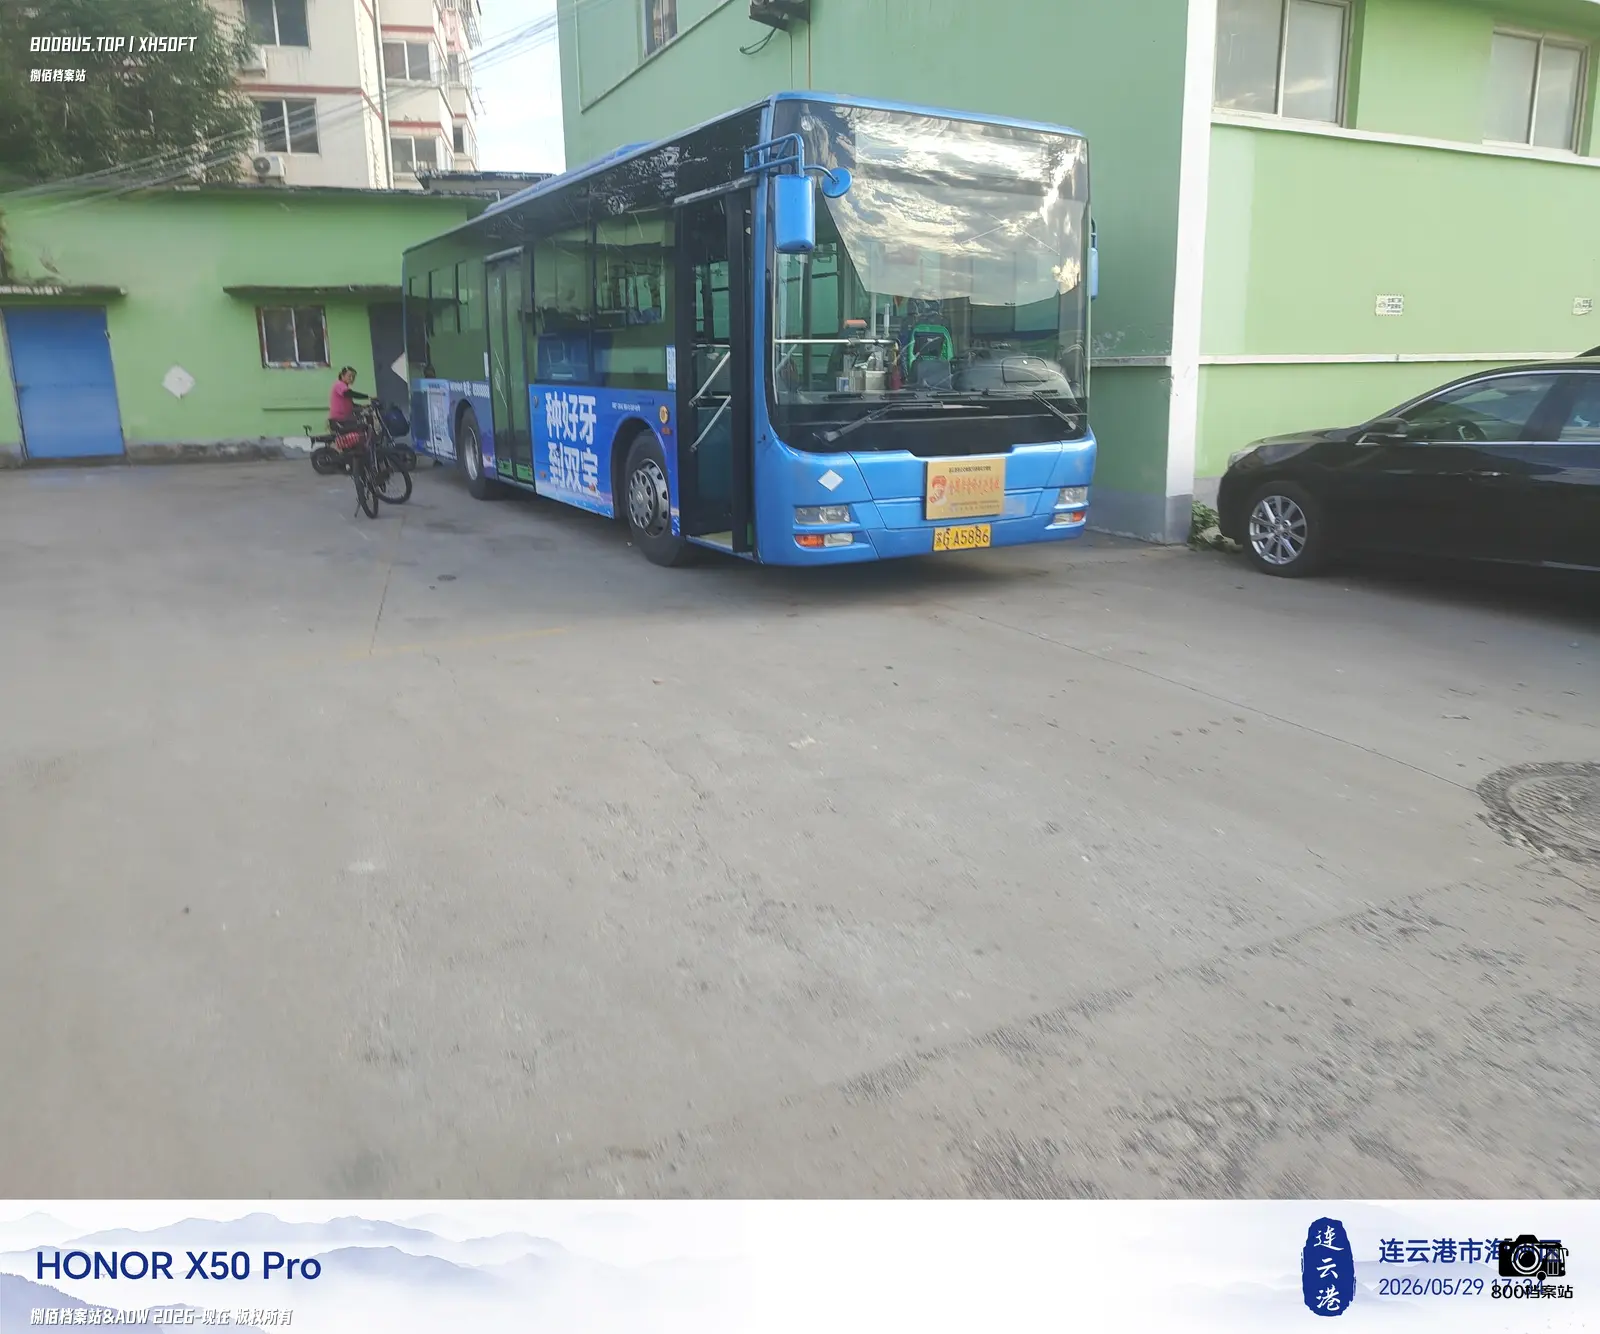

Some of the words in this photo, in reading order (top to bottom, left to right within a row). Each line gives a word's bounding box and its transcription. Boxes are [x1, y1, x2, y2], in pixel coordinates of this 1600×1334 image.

[545, 391, 597, 445] 种好牙
[547, 441, 600, 496] 到双宝
